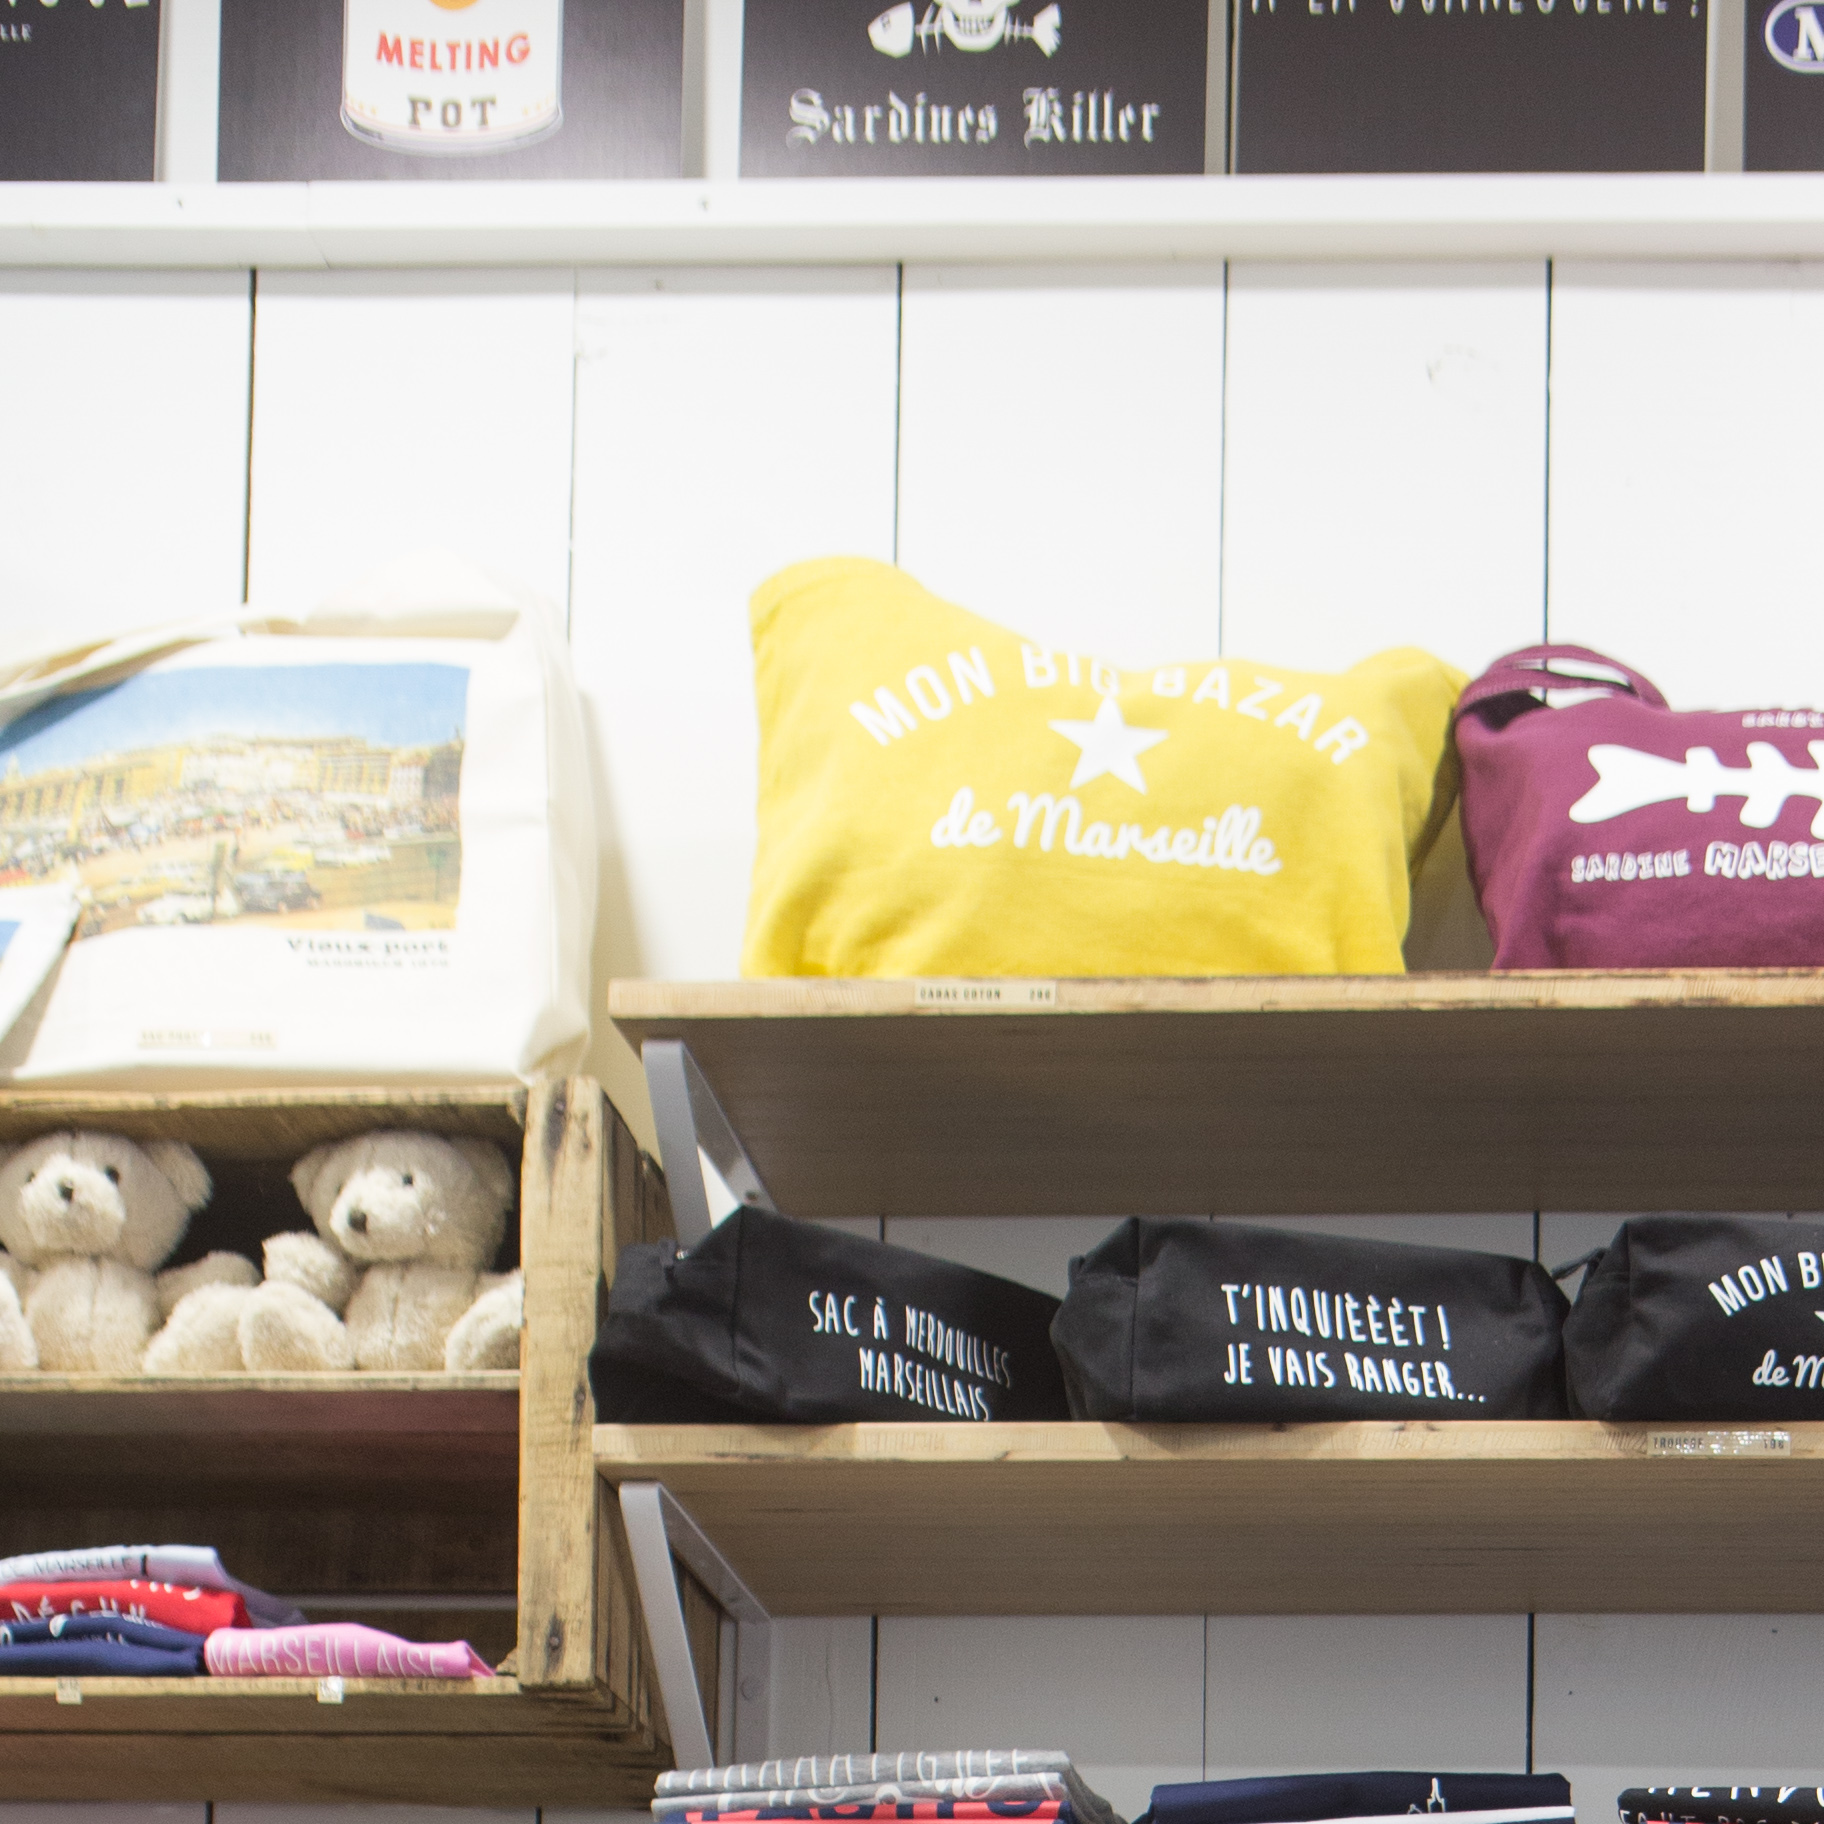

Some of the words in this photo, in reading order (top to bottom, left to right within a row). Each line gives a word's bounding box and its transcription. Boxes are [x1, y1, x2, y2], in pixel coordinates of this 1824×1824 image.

[376, 31, 532, 74] MELTING
[407, 95, 498, 132] POT
[786, 87, 999, 150] Sardines
[1023, 86, 1160, 150] Killer
[849, 646, 997, 747] MON
[1152, 666, 1371, 766] BAZAR
[931, 785, 1003, 849] de
[1007, 791, 1283, 877] Marseille
[1570, 849, 1690, 883] SARDINE
[1221, 1282, 1428, 1349] T'INQUIÈÈÈT
[1436, 1304, 1452, 1351] !
[1708, 1254, 1790, 1318] MON
[808, 1290, 860, 1337] SAC
[873, 1296, 889, 1341] À
[905, 1304, 1012, 1389] MERDOUILLES
[1753, 1348, 1790, 1388] de
[859, 1346, 991, 1423] MARSEILLAIS
[1223, 1341, 1253, 1386] JE
[1267, 1344, 1336, 1389] VAIS
[1344, 1351, 1487, 1403] RANGER...
[207, 1634, 447, 1677] MARSEILLAISE
